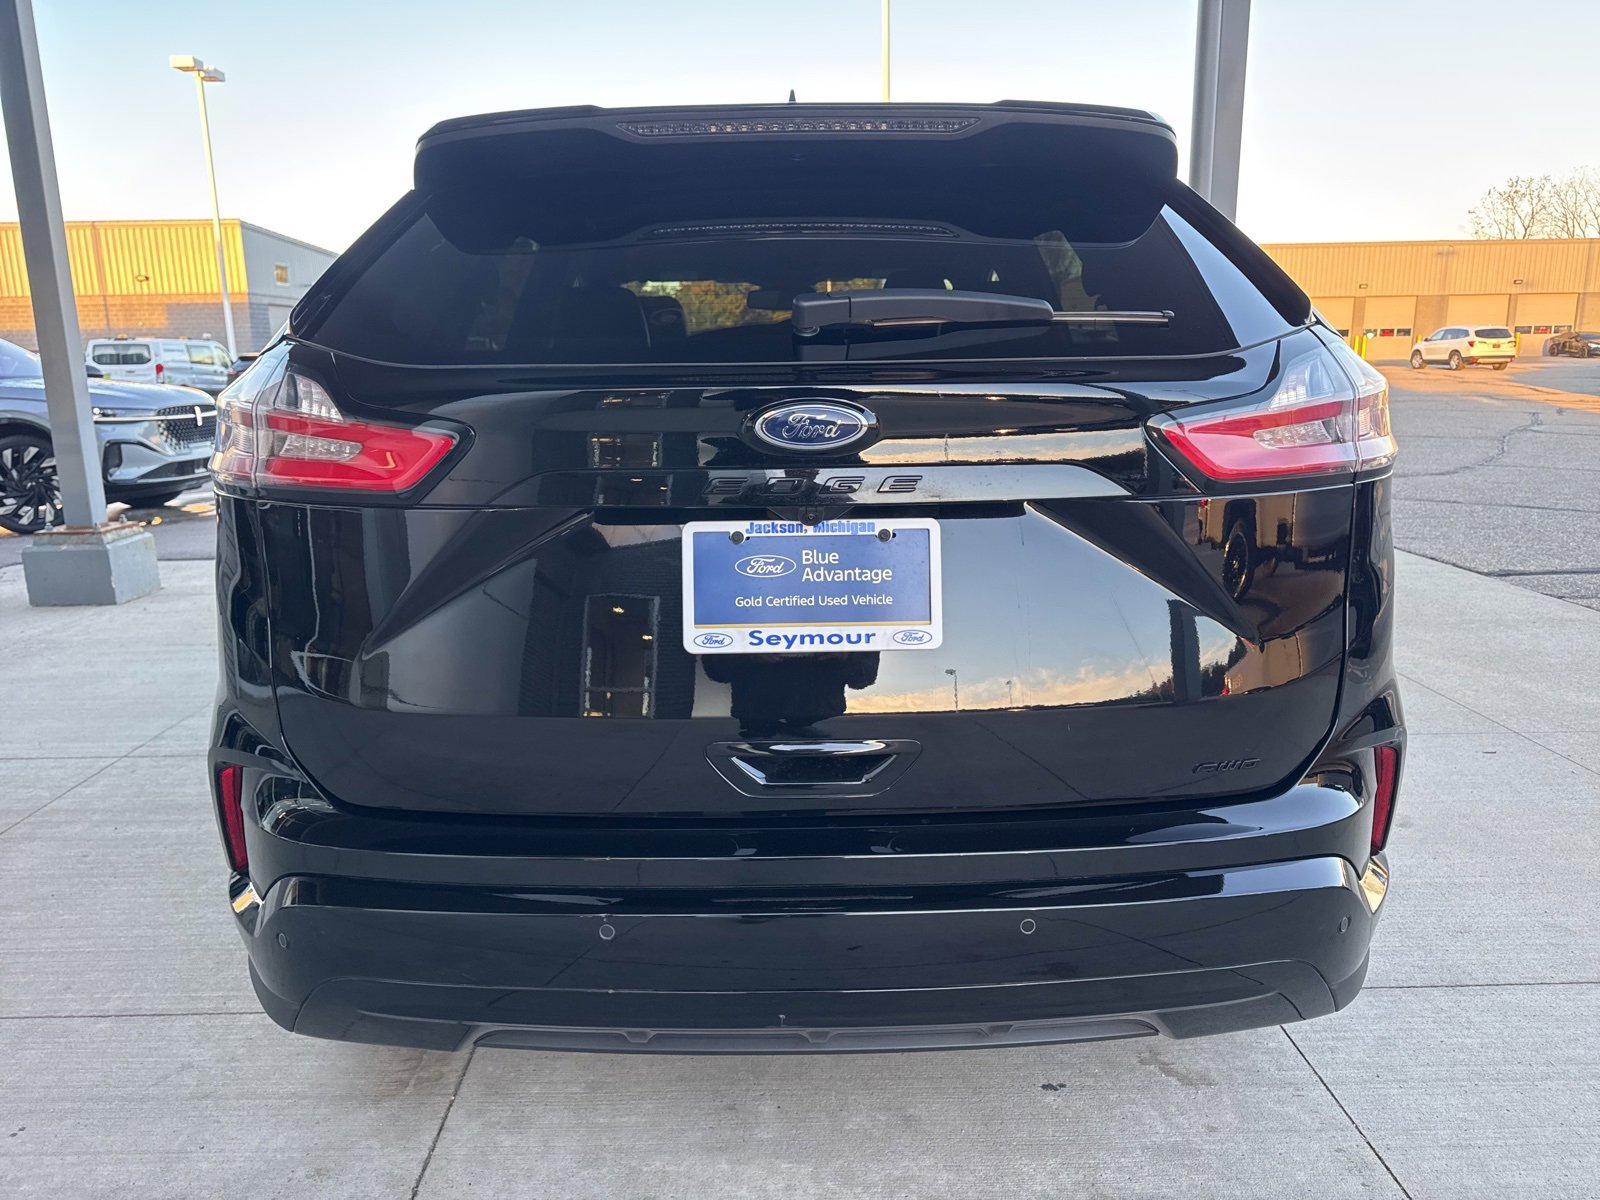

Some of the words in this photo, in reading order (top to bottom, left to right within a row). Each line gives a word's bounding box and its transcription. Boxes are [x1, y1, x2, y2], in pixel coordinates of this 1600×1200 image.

[782, 413, 842, 439] Ford
[703, 475, 923, 495] EDGE
[802, 550, 839, 564] Blue
[747, 558, 784, 574] Ford
[802, 566, 893, 583] Advantage
[735, 596, 762, 607] Gold
[766, 595, 815, 607] Certified
[818, 595, 848, 605] Used
[852, 594, 893, 605] Vehicle
[701, 633, 726, 646] Ford
[749, 630, 876, 649] Seymour
[901, 631, 925, 643] Ford
